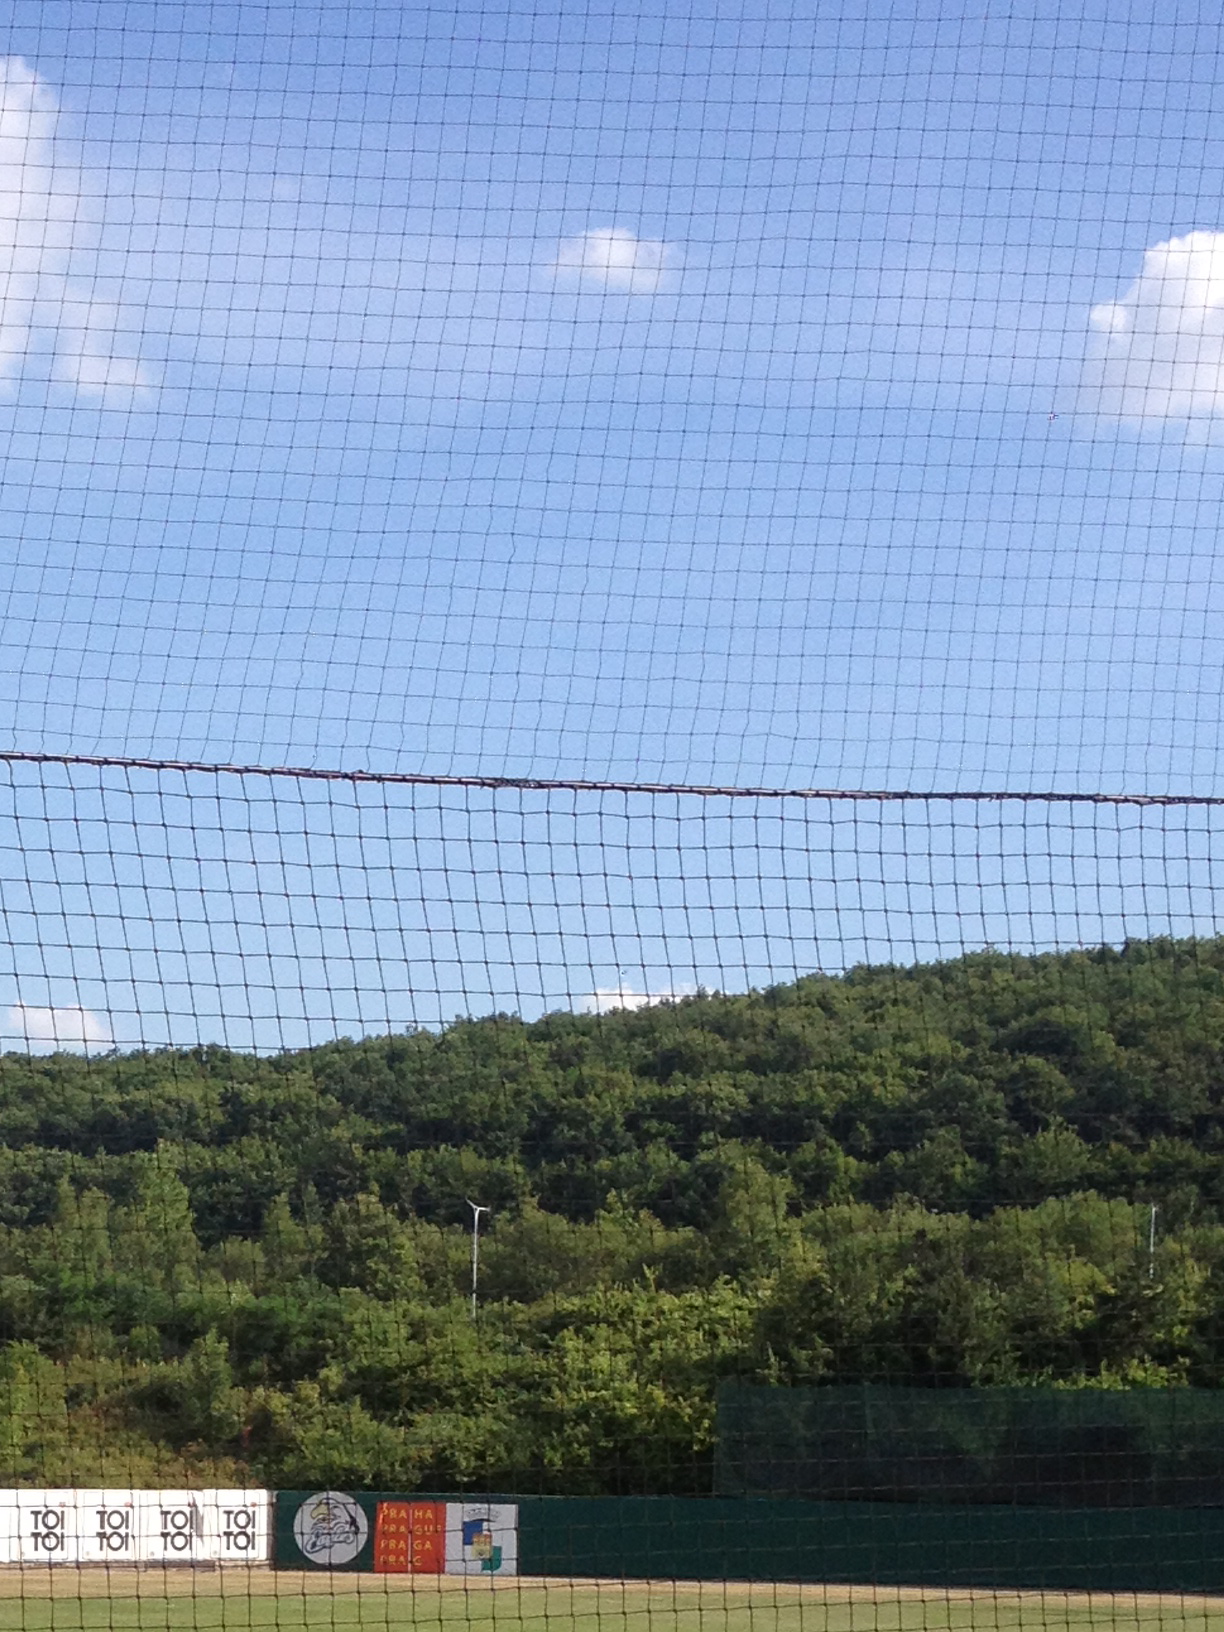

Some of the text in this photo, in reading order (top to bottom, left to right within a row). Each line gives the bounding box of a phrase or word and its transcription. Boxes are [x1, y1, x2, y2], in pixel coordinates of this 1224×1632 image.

[30, 1510, 65, 1530] TOI
[96, 1510, 129, 1530] TOI
[160, 1510, 192, 1530] TOI
[223, 1509, 256, 1529] TOI
[30, 1531, 65, 1551] TOI
[96, 1531, 129, 1551] TOI
[160, 1531, 192, 1551] TOI
[223, 1530, 256, 1550] TOI
